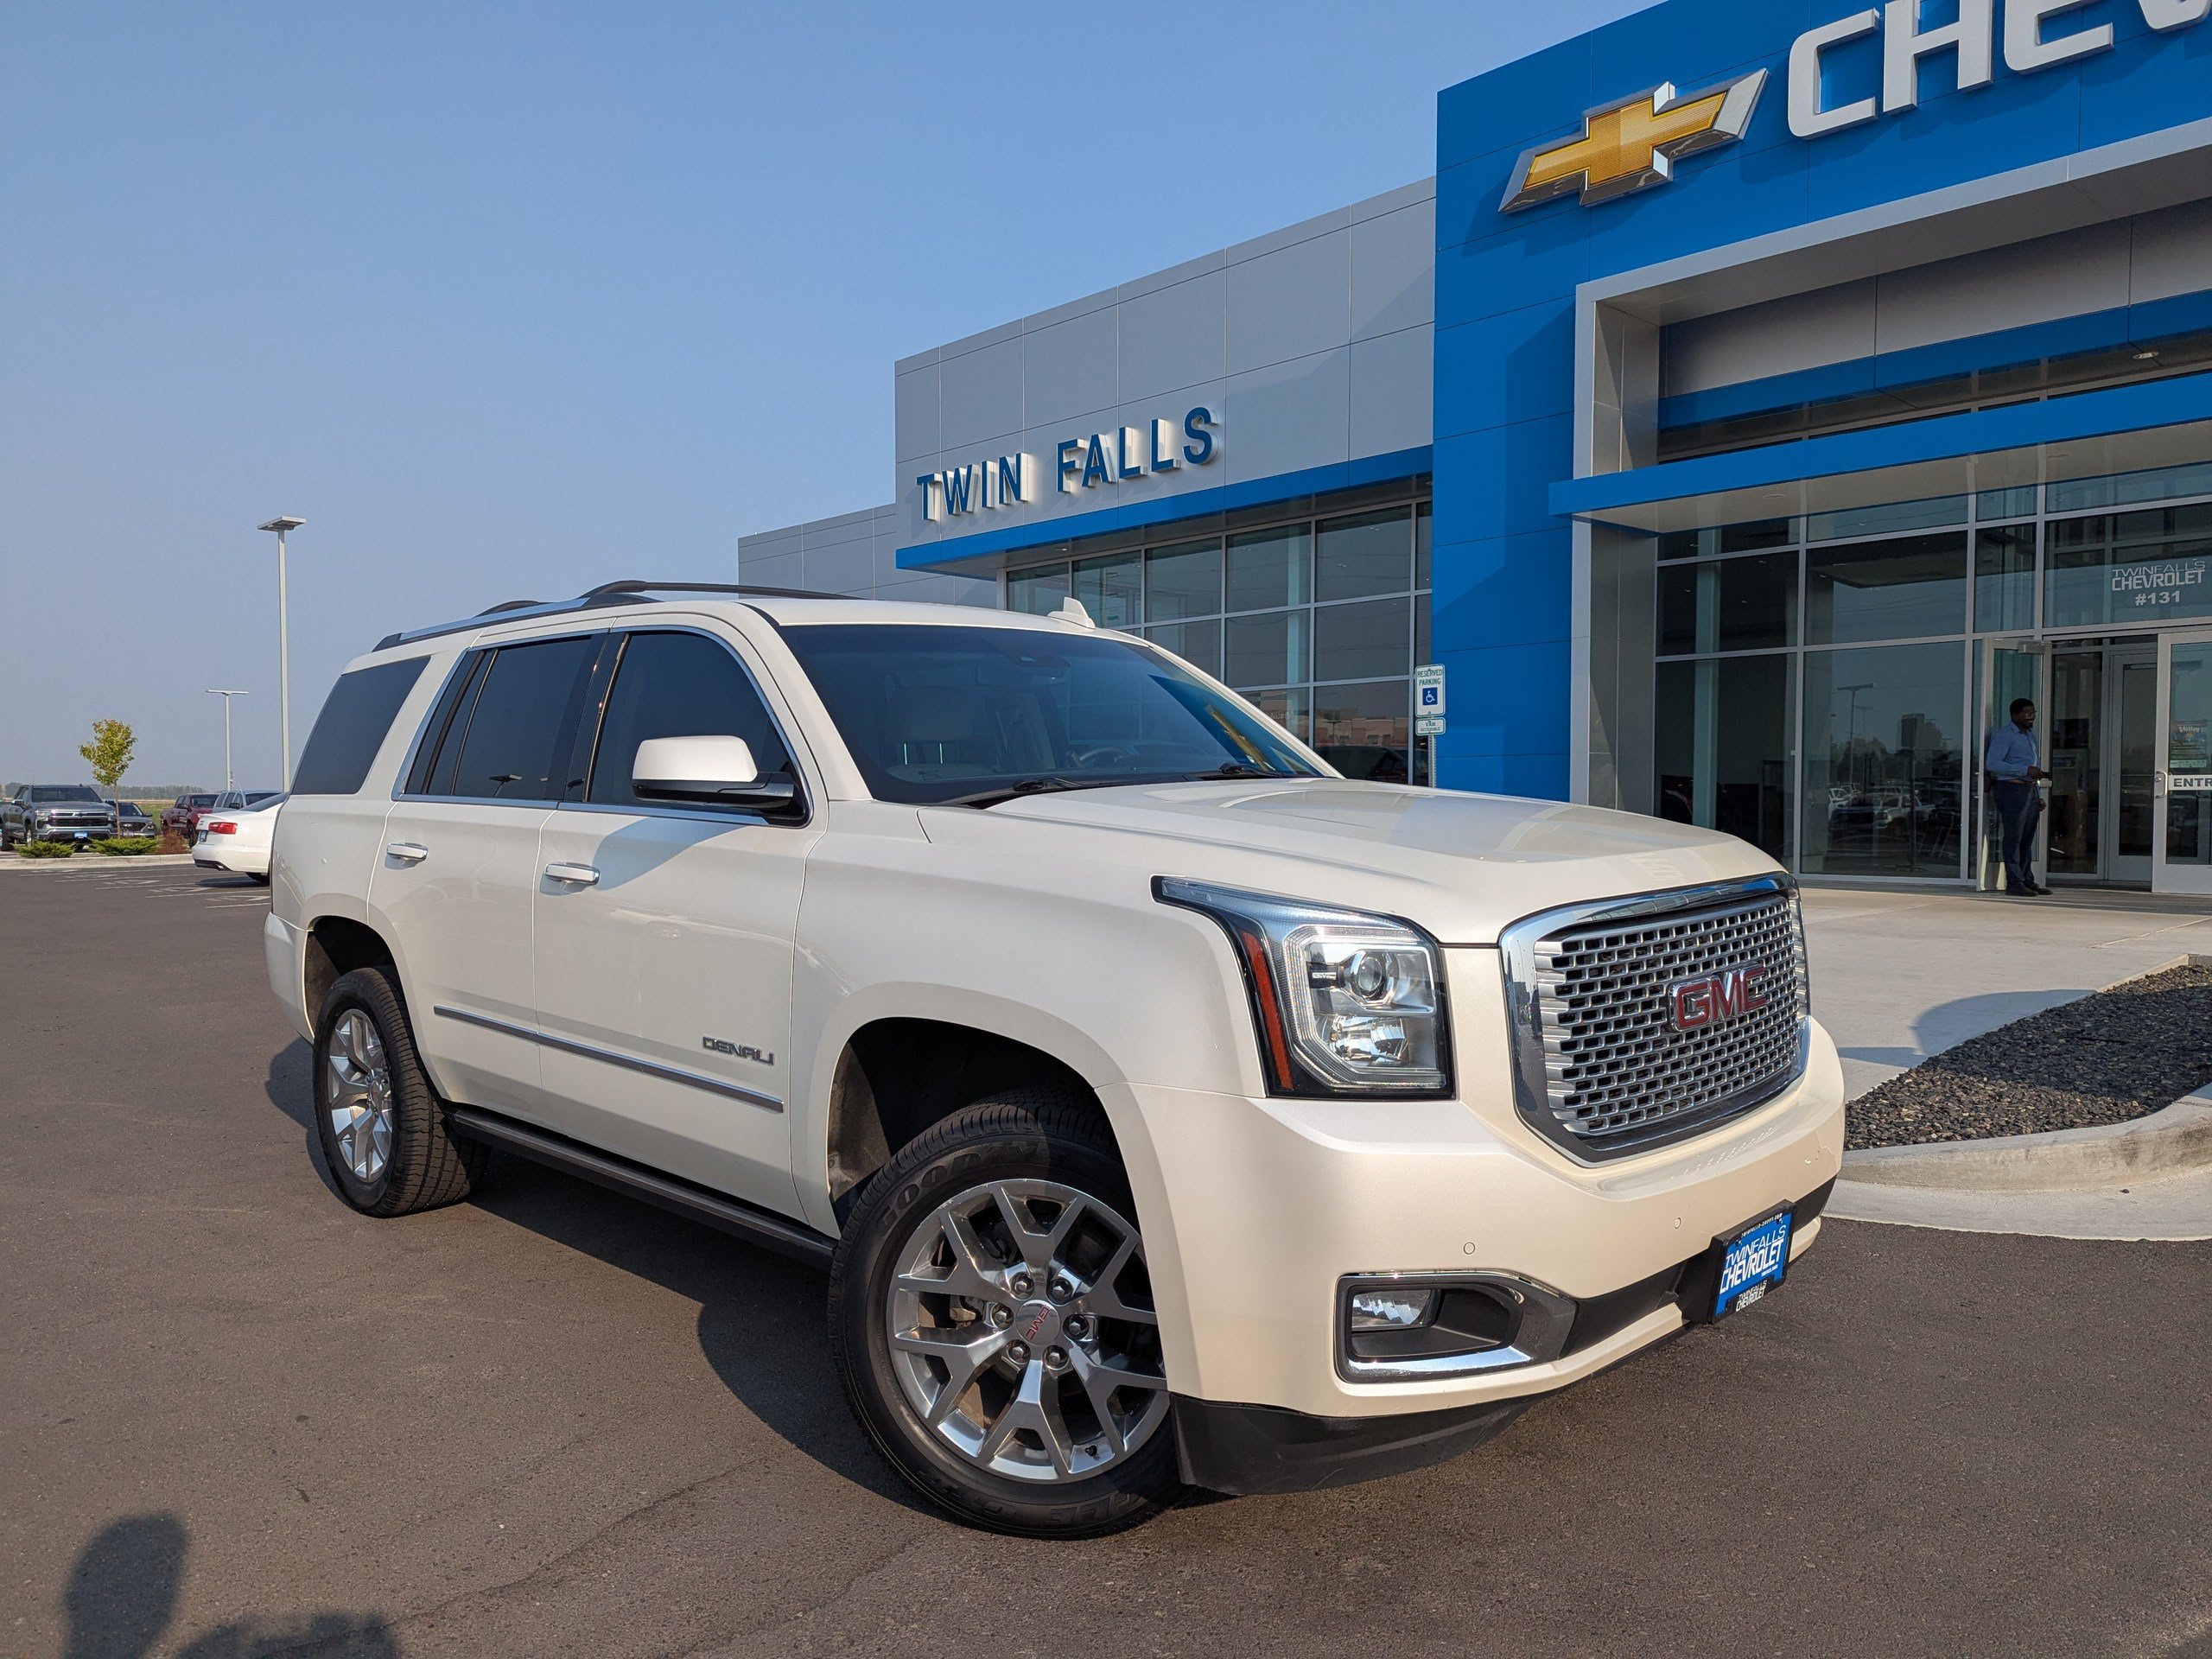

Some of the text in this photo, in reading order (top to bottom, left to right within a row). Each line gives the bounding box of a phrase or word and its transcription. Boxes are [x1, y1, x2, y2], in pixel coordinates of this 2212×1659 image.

[1788, 0, 2212, 140] CHE
[916, 406, 1218, 520] TWIN FALLS
[2112, 569, 2205, 591] CHEVROLET
[2135, 590, 2181, 606] #131
[1417, 669, 1443, 677] RESERVED
[1418, 677, 1441, 686] PARKING
[1673, 965, 1768, 1031] GMC
[702, 1036, 774, 1066] DENALI
[1719, 1237, 1784, 1294] CHEVROLET
[1735, 1287, 1765, 1312] CHEVROLET
[1026, 1304, 1051, 1340] GMC
